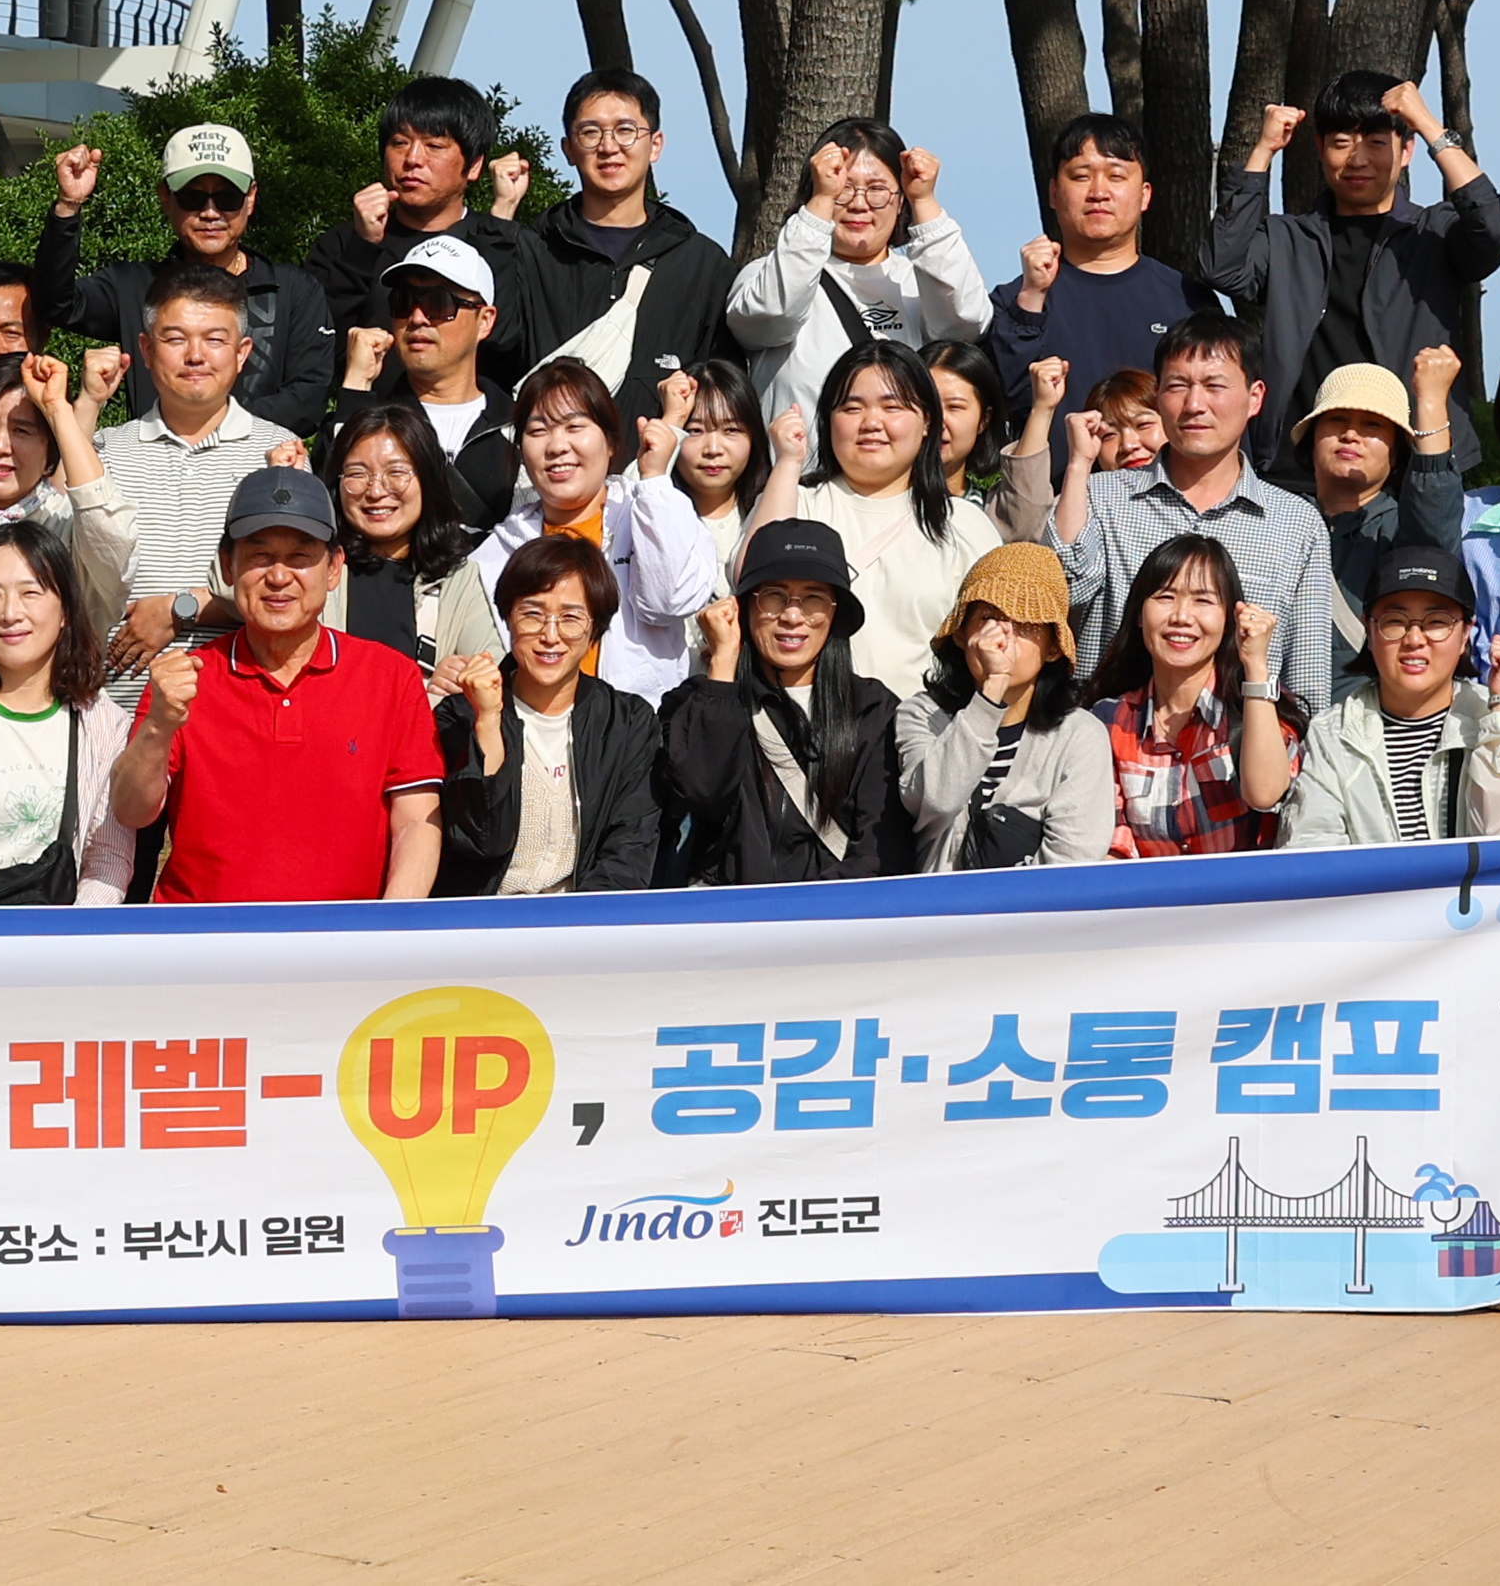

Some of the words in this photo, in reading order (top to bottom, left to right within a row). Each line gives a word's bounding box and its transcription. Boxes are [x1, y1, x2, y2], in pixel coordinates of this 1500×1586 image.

[188, 141, 232, 155] Windy
[190, 131, 229, 145] Misty
[195, 152, 226, 163] Jeju
[1213, 1001, 1440, 1114] 캠프
[565, 1204, 713, 1246] Jindo
[758, 1196, 881, 1237] 진도군
[124, 1220, 248, 1261] 부산시
[261, 1216, 345, 1256] 일원
